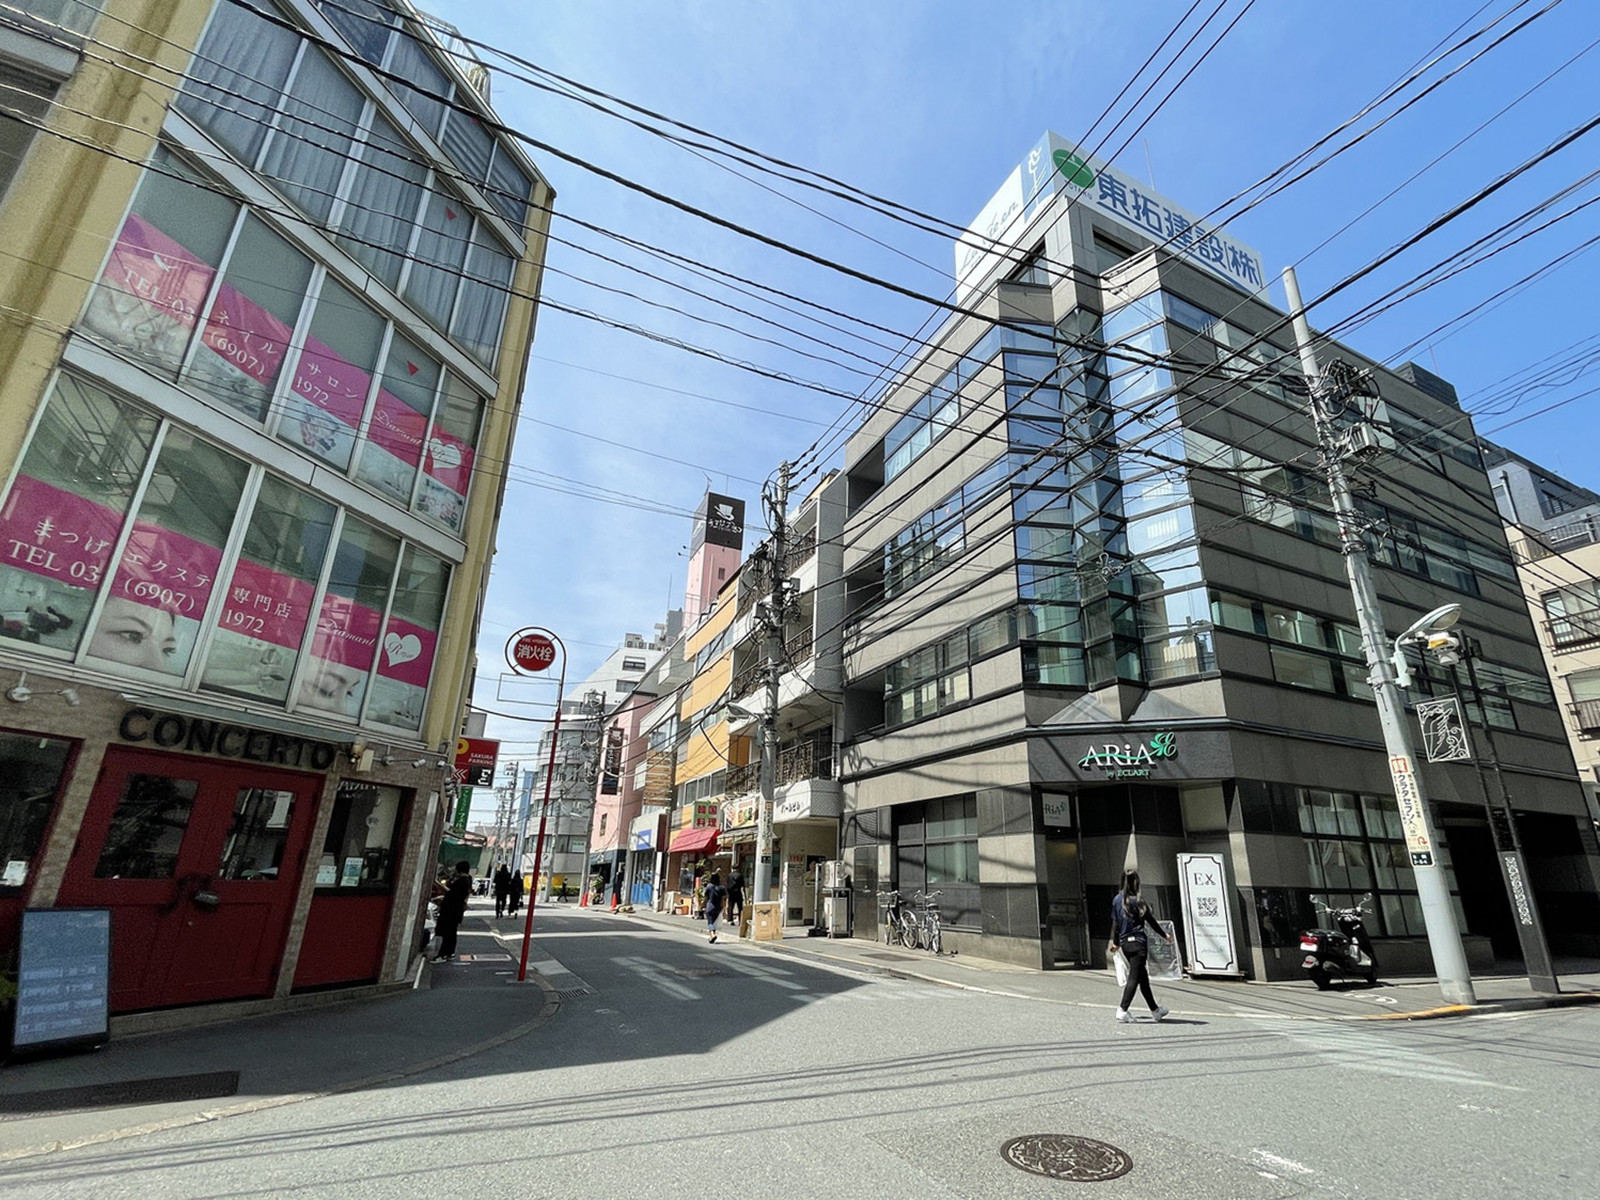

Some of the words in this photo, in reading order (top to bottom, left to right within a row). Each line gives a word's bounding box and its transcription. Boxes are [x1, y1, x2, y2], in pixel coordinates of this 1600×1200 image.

[123, 265, 168, 308] TEL
[171, 298, 195, 321] 03
[210, 331, 265, 376] (6907)
[296, 376, 329, 406] 1972
[217, 309, 278, 355] ネイル
[307, 361, 358, 398] サロン
[8, 539, 61, 572] TEL
[70, 561, 100, 583] 03
[124, 577, 195, 611] (6907)
[225, 609, 265, 634] 1972
[34, 518, 110, 554] まつげ
[124, 552, 210, 588] エクステ
[517, 643, 553, 662] 消火栓
[119, 707, 336, 770] CONCERTO
